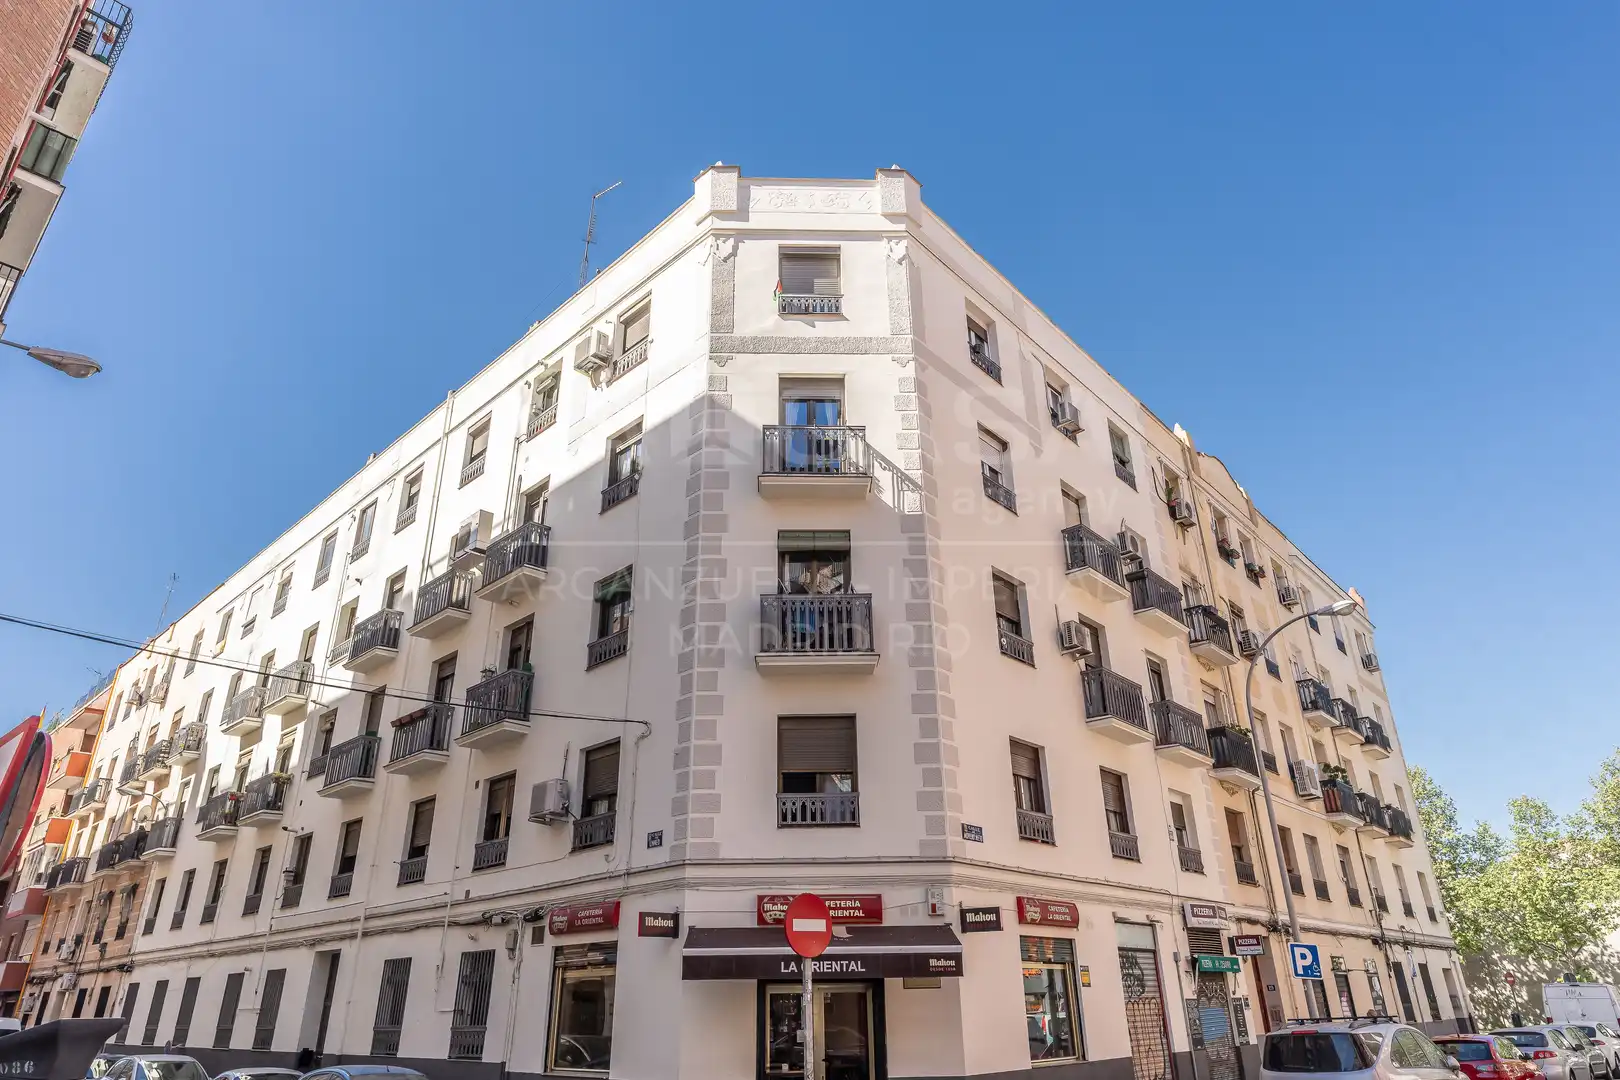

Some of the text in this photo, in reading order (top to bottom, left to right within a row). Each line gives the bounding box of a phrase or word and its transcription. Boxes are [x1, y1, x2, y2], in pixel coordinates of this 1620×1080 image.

[763, 903, 788, 911] Maho
[825, 899, 860, 908] FETERÍA
[829, 909, 865, 917] RIENTAL
[966, 911, 997, 923] Mahou
[645, 916, 674, 928] Mahou
[929, 958, 956, 966] Mahou
[1294, 947, 1313, 975] P
[781, 960, 866, 973] LA RIENTAL
